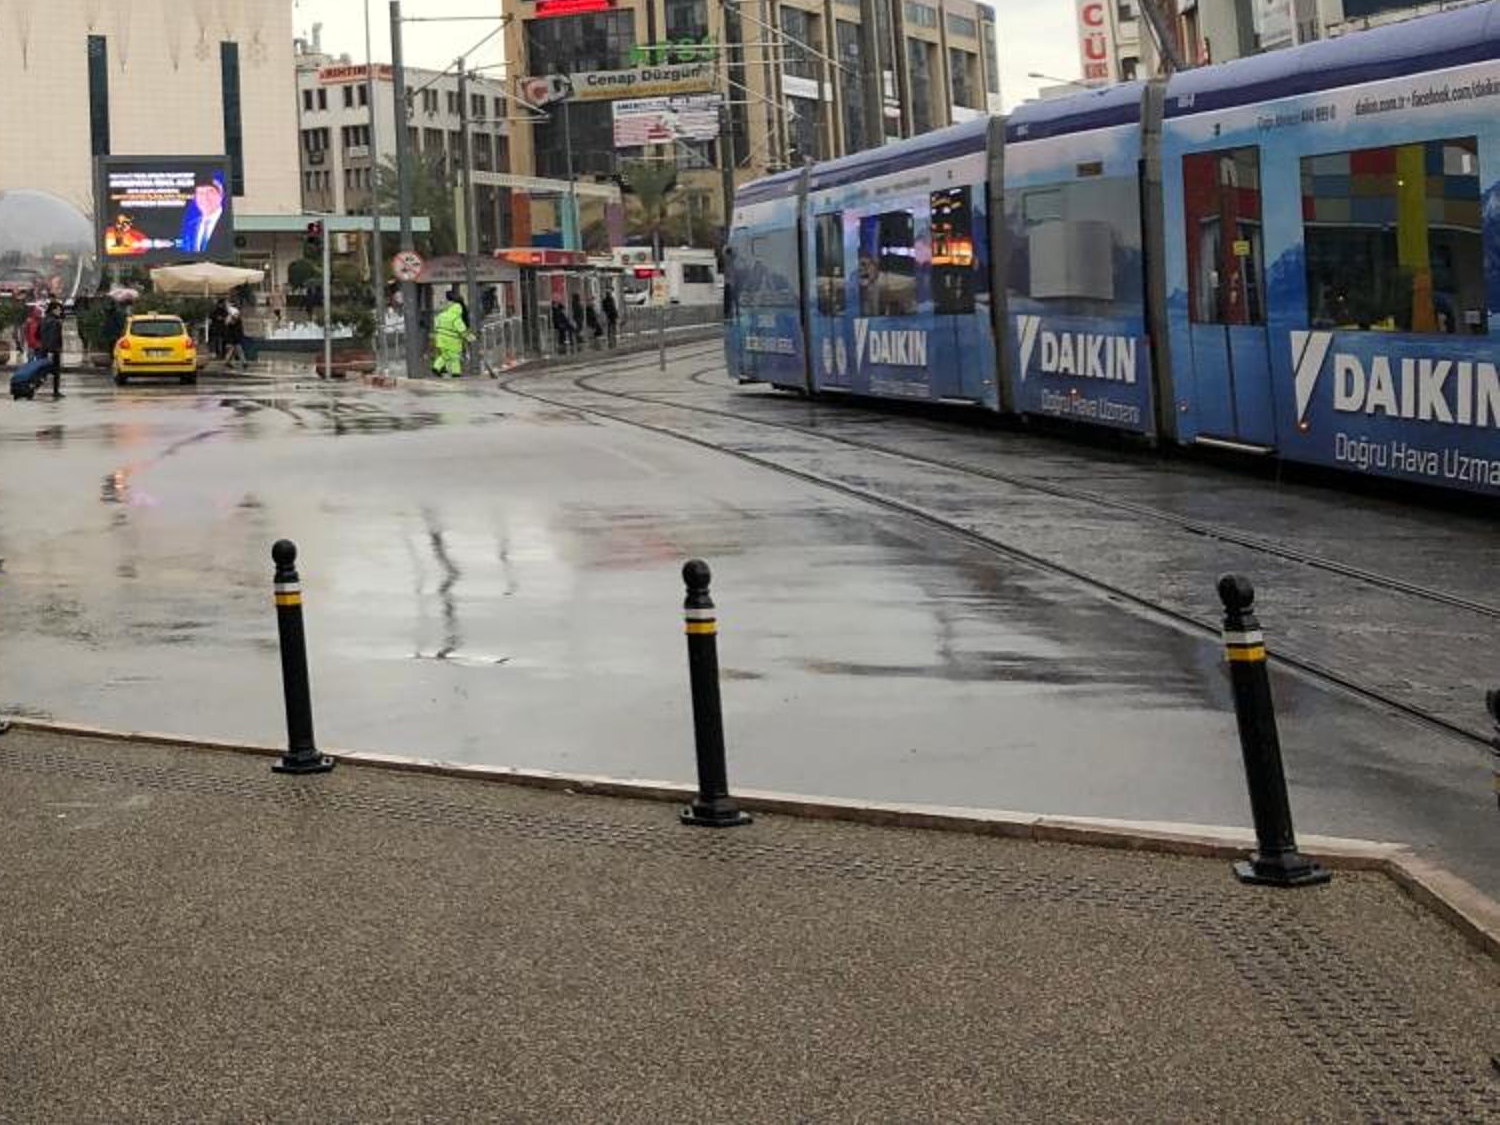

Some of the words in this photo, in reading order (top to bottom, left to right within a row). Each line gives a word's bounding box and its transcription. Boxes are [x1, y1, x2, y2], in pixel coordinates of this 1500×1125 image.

[587, 73, 636, 88] Cenap
[870, 330, 928, 367] DAIKIN
[1041, 330, 1137, 384] DAIKIN
[1335, 432, 1387, 469] Doğru
[1391, 440, 1439, 476] Hava
